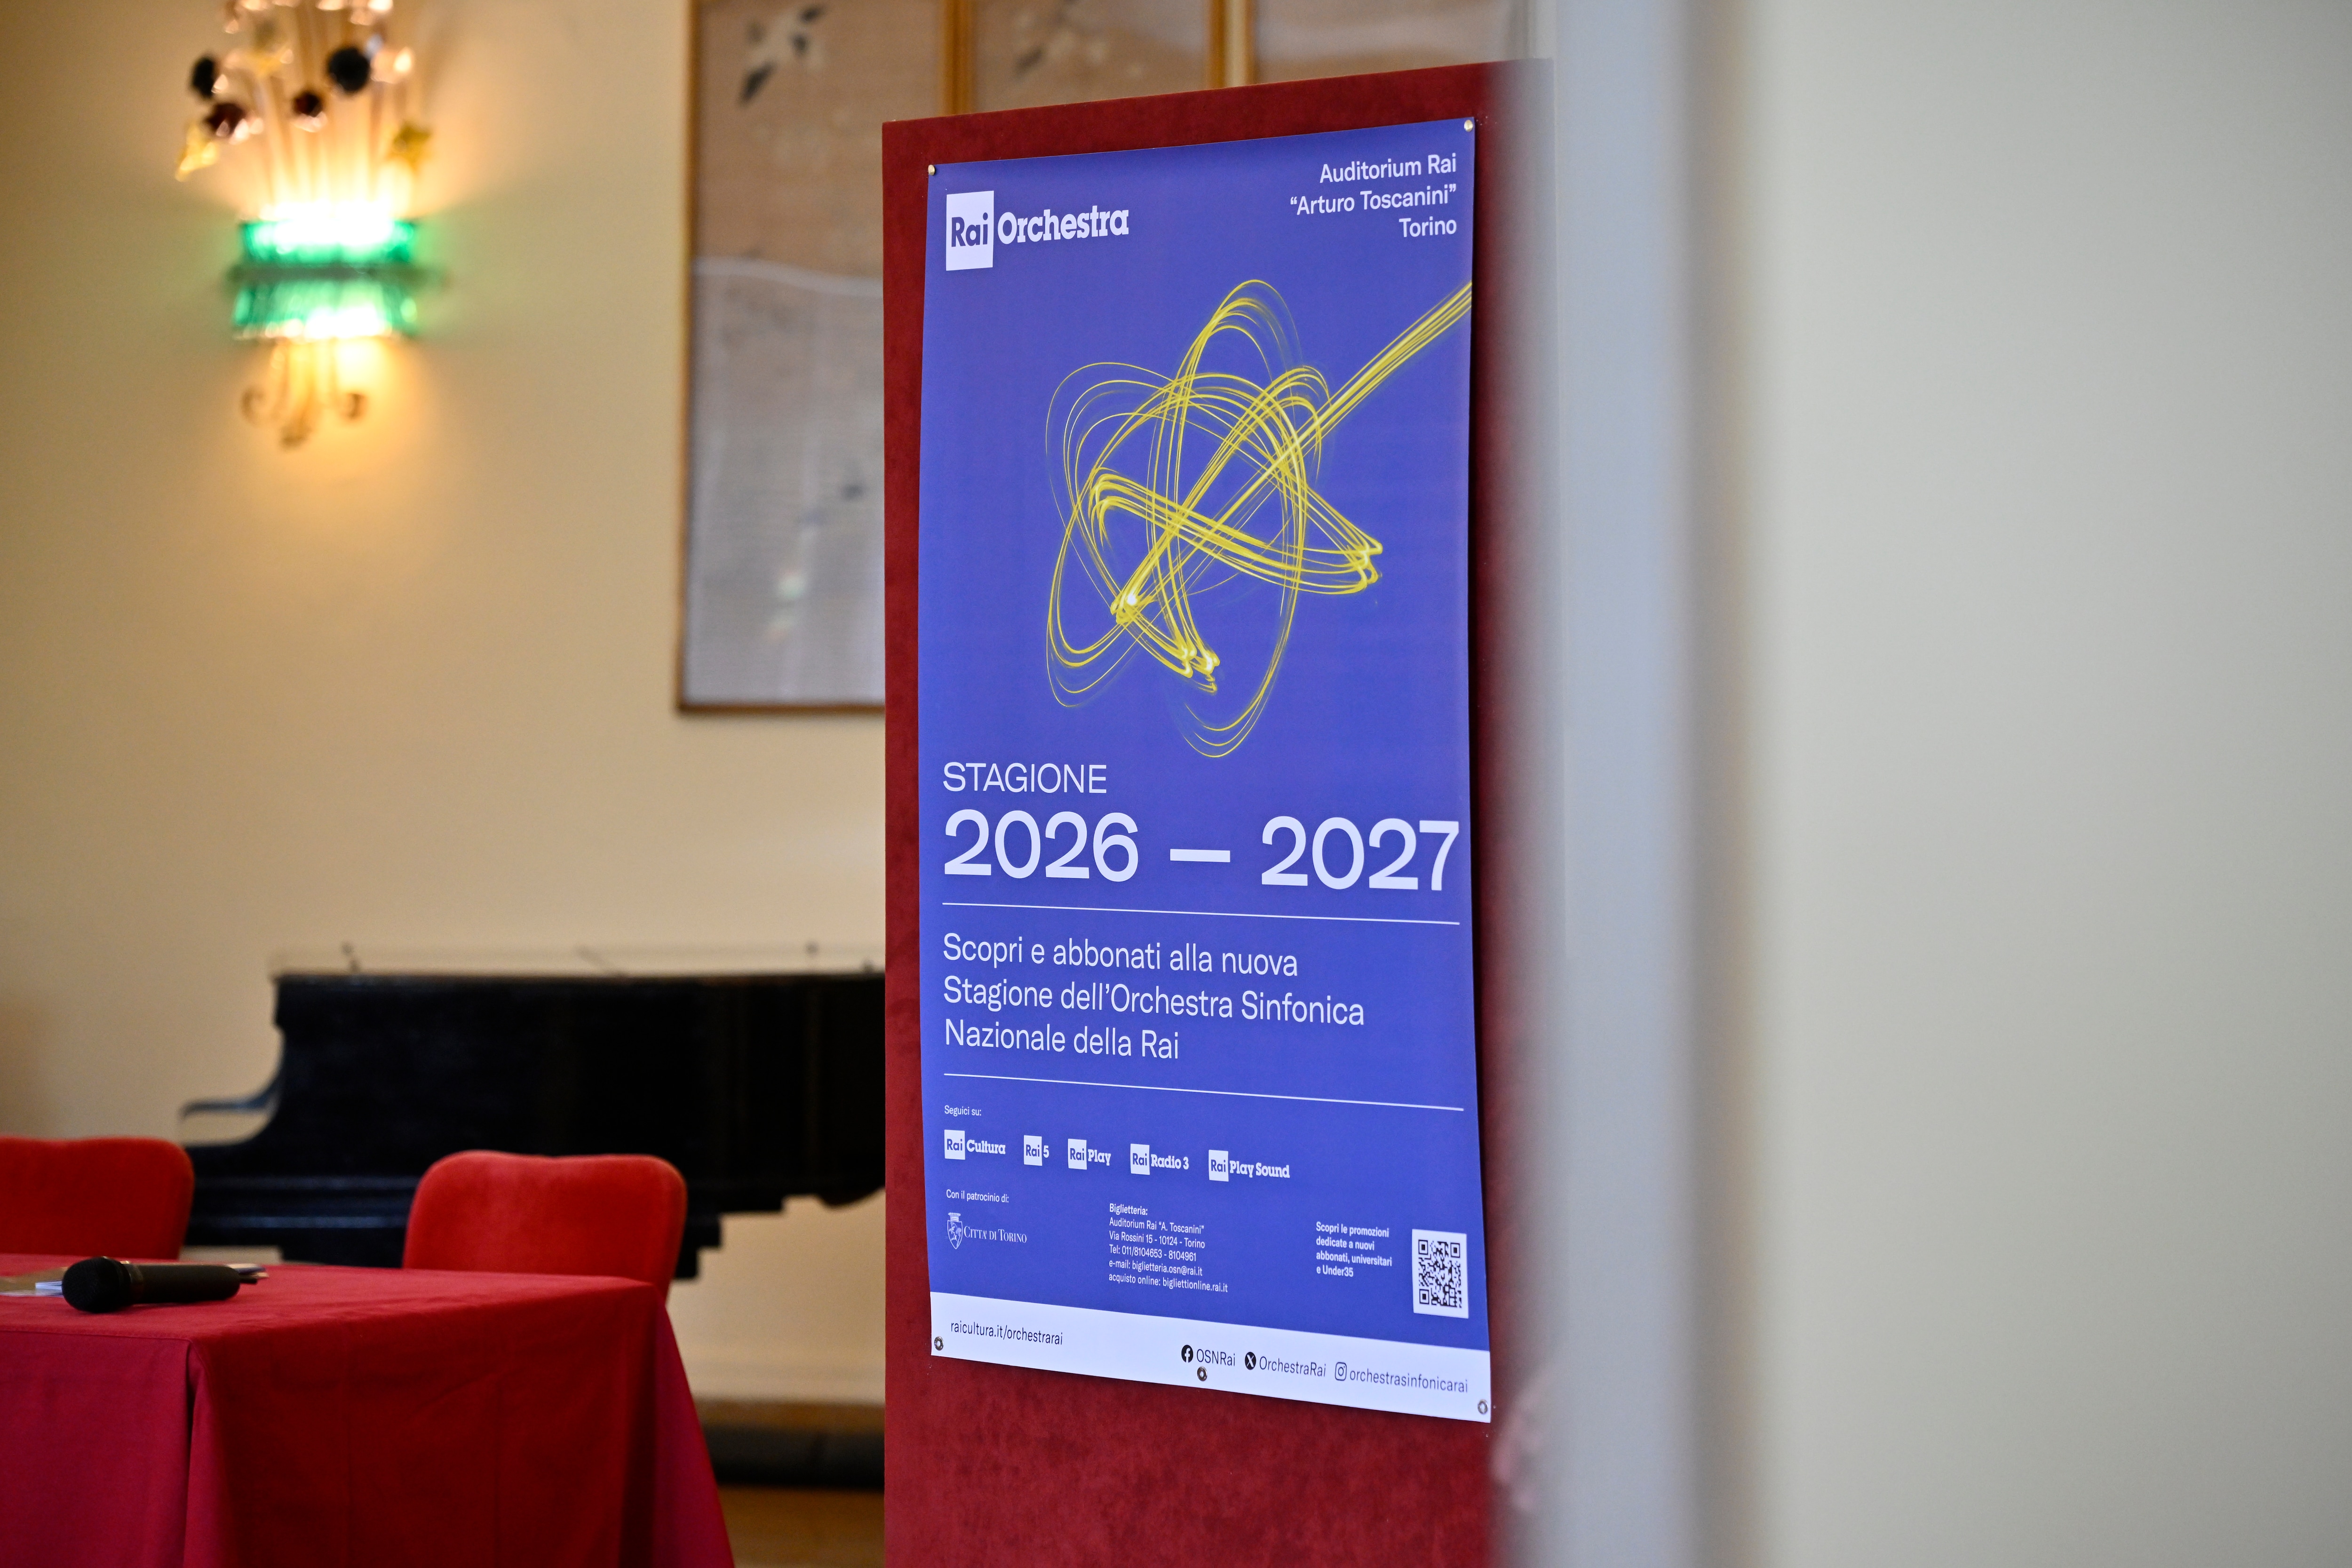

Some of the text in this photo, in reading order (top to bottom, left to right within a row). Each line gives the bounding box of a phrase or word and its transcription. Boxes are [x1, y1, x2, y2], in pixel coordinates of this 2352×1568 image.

[1319, 153, 1457, 184] Auditorium Rai
[1290, 184, 1458, 216] “Arturo Toscanini”
[951, 205, 1129, 247] Rai Orchestra
[1399, 216, 1457, 239] Torino
[943, 762, 1107, 794] STAGIONE
[944, 809, 1139, 883] 2026
[1261, 816, 1459, 891] 2027
[943, 932, 1298, 976] Scopri e abbonati alla nuova
[944, 975, 1365, 1025] Stagione dell’Orchestra Sinfonica
[946, 1019, 1178, 1059] Nazionale della Rai
[944, 1105, 982, 1117] Seguici su:
[946, 1138, 1006, 1154] Rai Cultura
[1026, 1145, 1049, 1158] Rai 5
[1070, 1148, 1111, 1166] Rai Play
[1132, 1153, 1189, 1170] Rai Radio 3
[1211, 1159, 1290, 1178] Rai Play Sound
[946, 1189, 959, 1199] Con
[961, 1190, 964, 1200] il
[967, 1192, 1000, 1202] patrocinio
[1109, 1203, 1148, 1216] Biglietteria:
[1109, 1217, 1204, 1234] Auditorium Rai “A. Toscanini”
[1316, 1221, 1389, 1237] Scopri le promozioni
[989, 1230, 996, 1241] DI
[998, 1229, 1027, 1243] TORINO
[1109, 1231, 1119, 1241] Via
[1121, 1232, 1144, 1243] Rossini
[1146, 1234, 1152, 1244] 15
[1159, 1236, 1177, 1246] 10124
[1184, 1238, 1205, 1249] Torino
[1316, 1236, 1347, 1248] dedicate
[1355, 1241, 1375, 1250] nuovi
[1109, 1244, 1120, 1255] Tel:
[1122, 1245, 1162, 1258] 011/8104653
[1168, 1250, 1196, 1262] 8104961
[1316, 1251, 1392, 1266] abbonati, universitari
[1109, 1258, 1202, 1276] e-mail: biglietteria.osn@rai.it
[1322, 1265, 1353, 1277] Under35
[1109, 1273, 1228, 1293] acquisto online: bigliettionline.rai.it
[951, 1321, 1063, 1345] raicultura.it/orchestrarai
[1196, 1348, 1235, 1367] OSNRai
[1259, 1356, 1326, 1377] OrchestraRai
[1350, 1368, 1468, 1393] orchestrasinfonicarai
